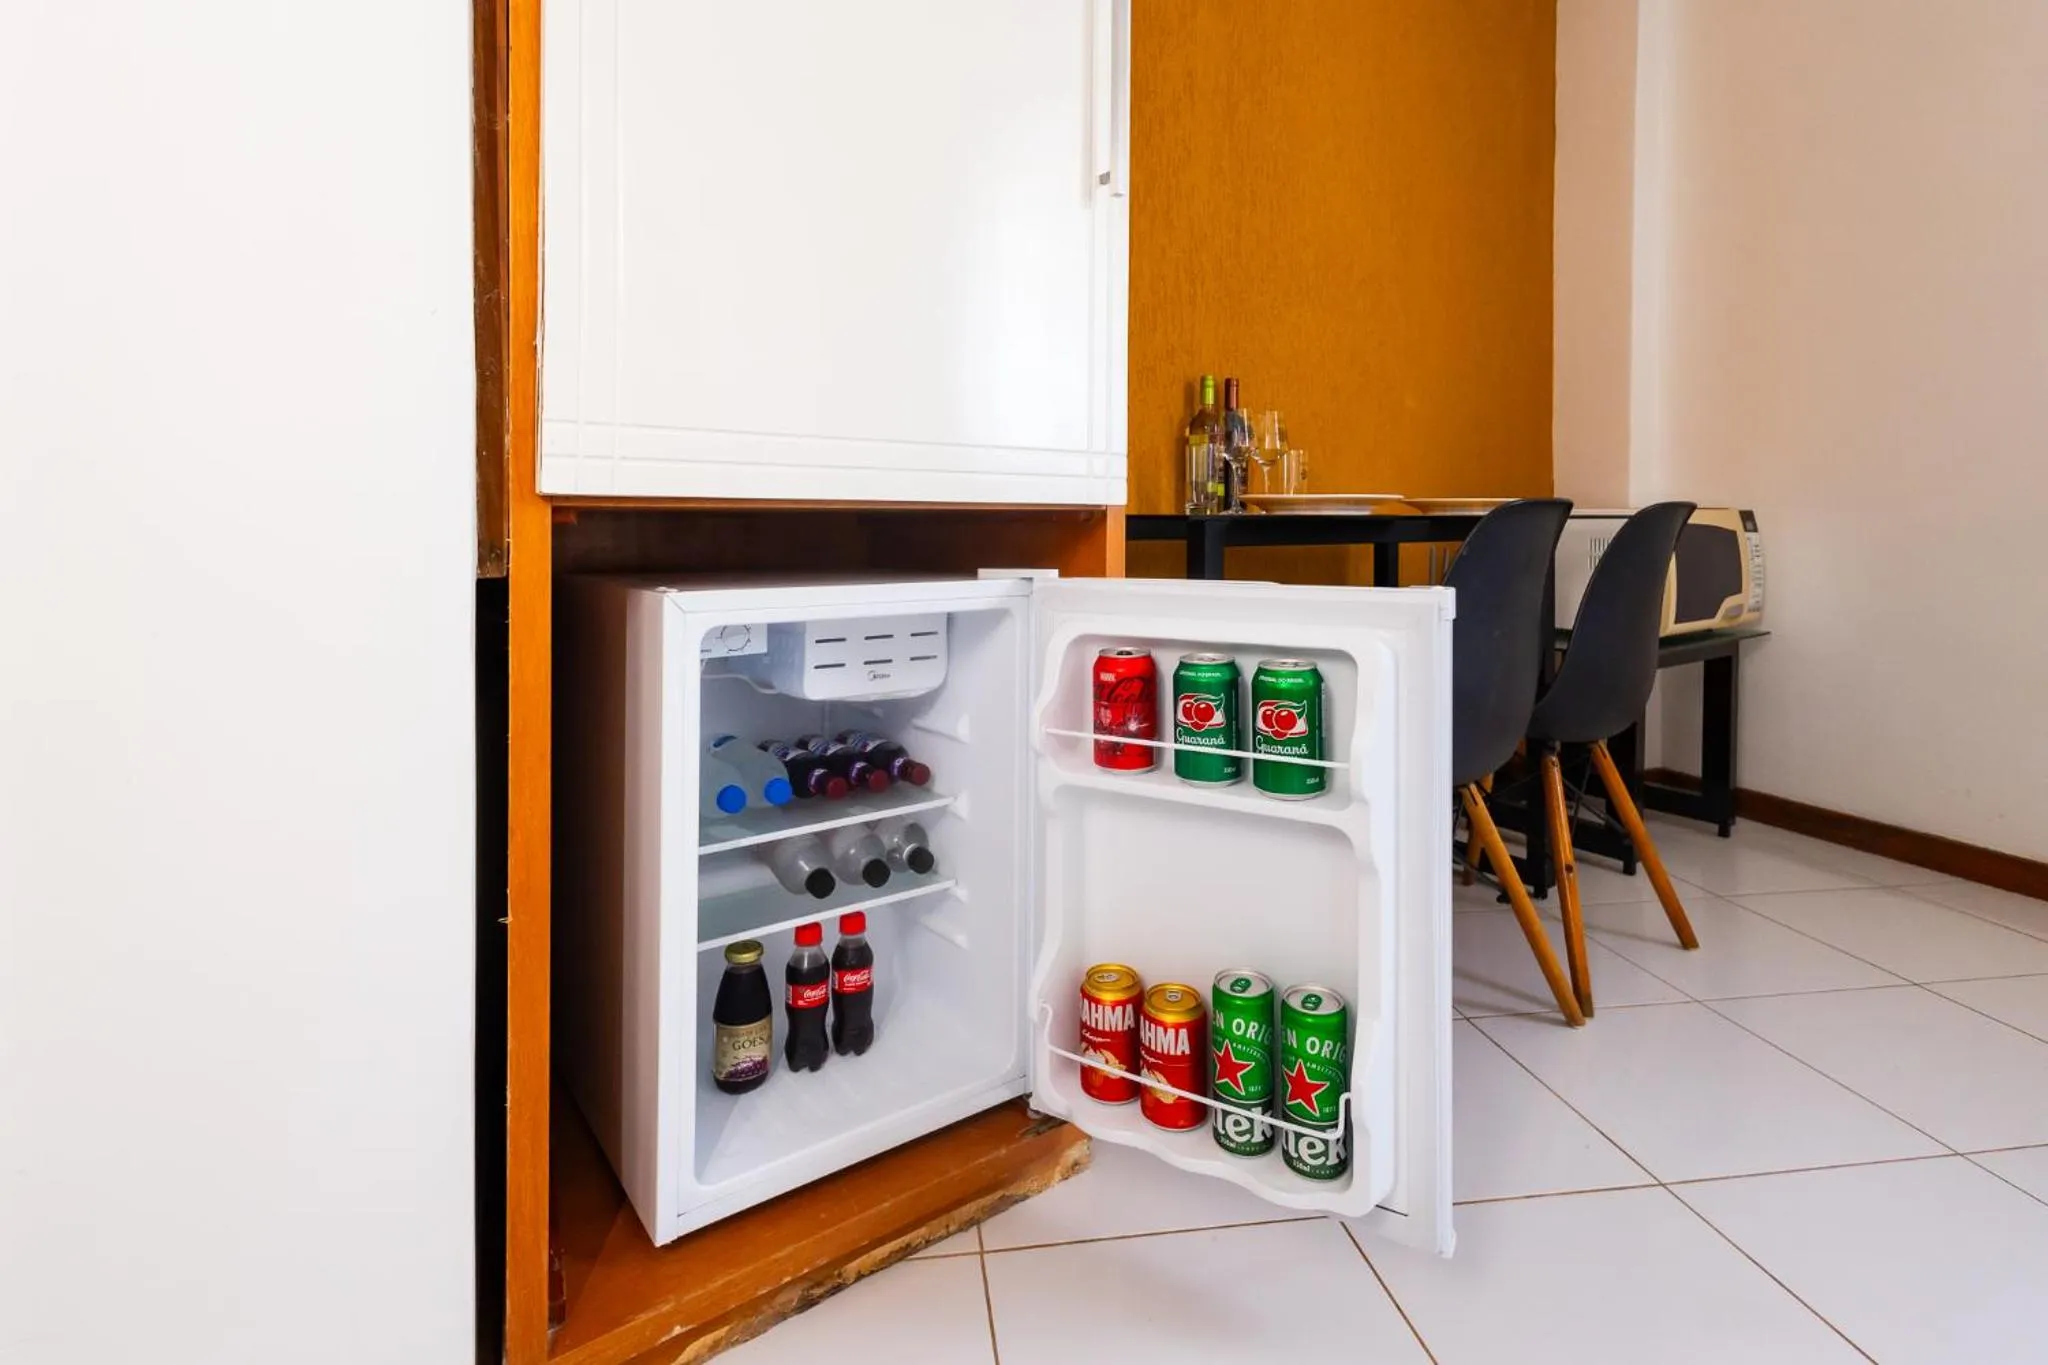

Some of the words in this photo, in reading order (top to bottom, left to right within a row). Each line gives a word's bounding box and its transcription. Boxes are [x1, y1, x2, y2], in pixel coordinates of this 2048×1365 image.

[1176, 727, 1226, 746] Guaraná
[1256, 735, 1309, 755] Guaraná
[1080, 996, 1135, 1032] AHMA
